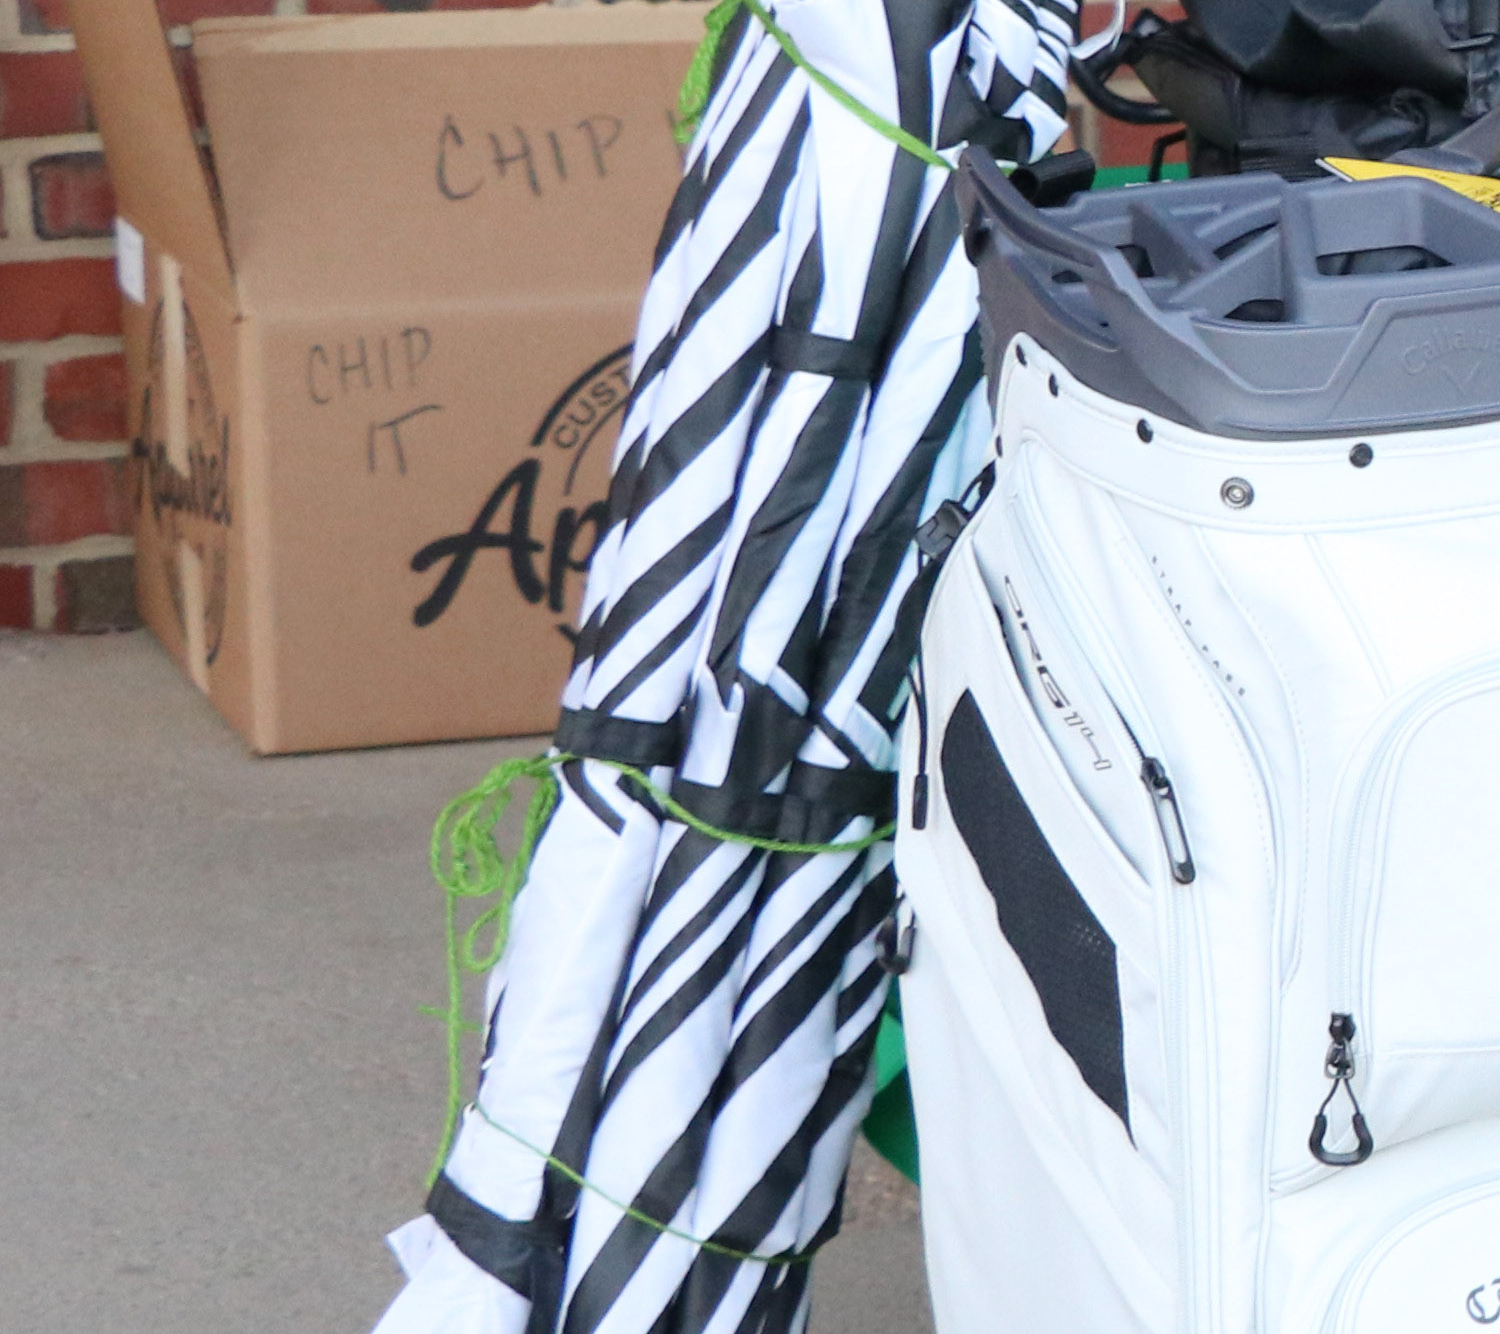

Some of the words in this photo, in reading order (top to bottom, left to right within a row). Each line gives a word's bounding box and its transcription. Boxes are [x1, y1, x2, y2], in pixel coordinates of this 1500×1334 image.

[436, 113, 624, 202] CHIP
[306, 326, 432, 406] CHIP
[553, 363, 634, 450] CUST
[367, 403, 444, 475] IT
